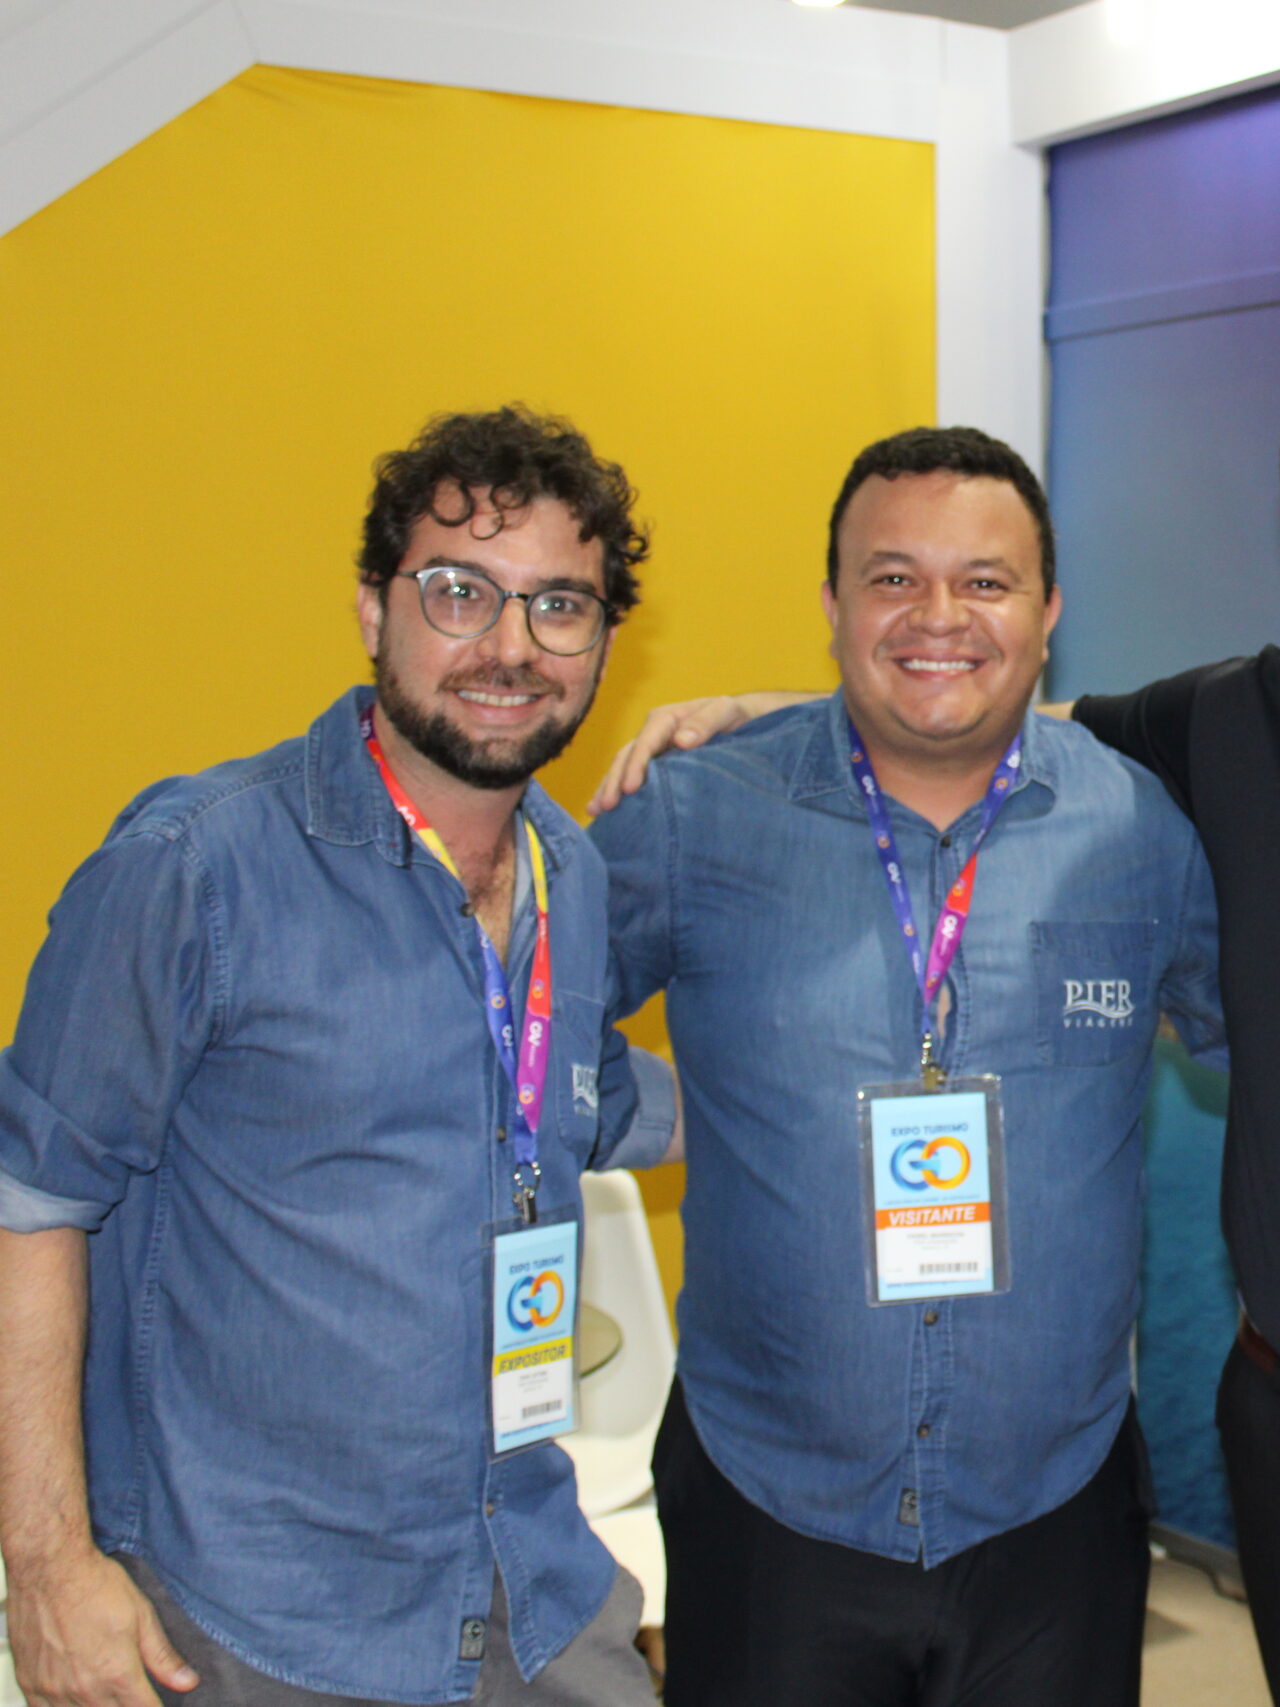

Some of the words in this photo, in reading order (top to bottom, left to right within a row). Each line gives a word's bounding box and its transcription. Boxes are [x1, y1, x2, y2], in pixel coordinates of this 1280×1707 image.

[1063, 979, 1134, 1012] PIER
[889, 1206, 976, 1226] VISITANTE
[499, 1344, 567, 1374] EXPOSITOR
